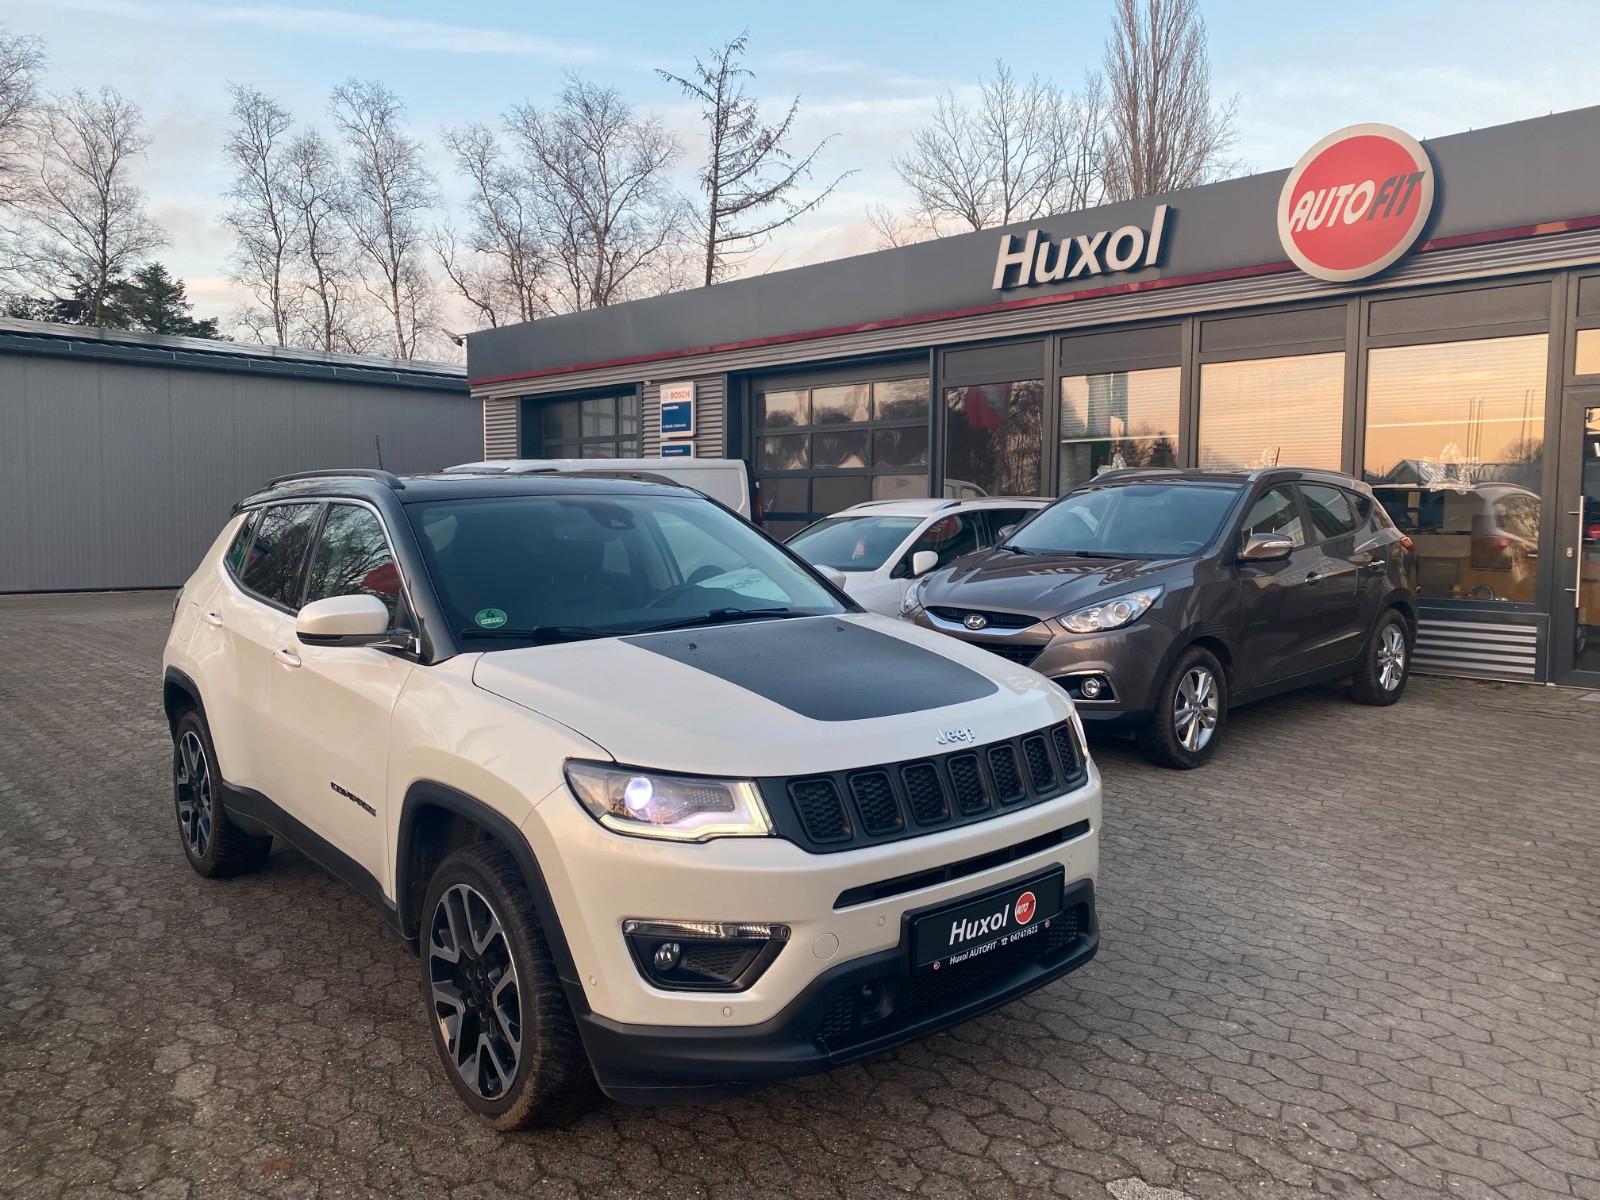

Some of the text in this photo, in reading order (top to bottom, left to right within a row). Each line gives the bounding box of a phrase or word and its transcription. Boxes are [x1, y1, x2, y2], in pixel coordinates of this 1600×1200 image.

[1290, 171, 1425, 233] AUTOFIT
[992, 204, 1170, 291] Huxol
[671, 390, 690, 400] BOSCH
[936, 727, 976, 745] Jeep
[949, 904, 1010, 946] Huxol
[949, 952, 969, 965] Huxol
[968, 941, 998, 959] AUTOFIT
